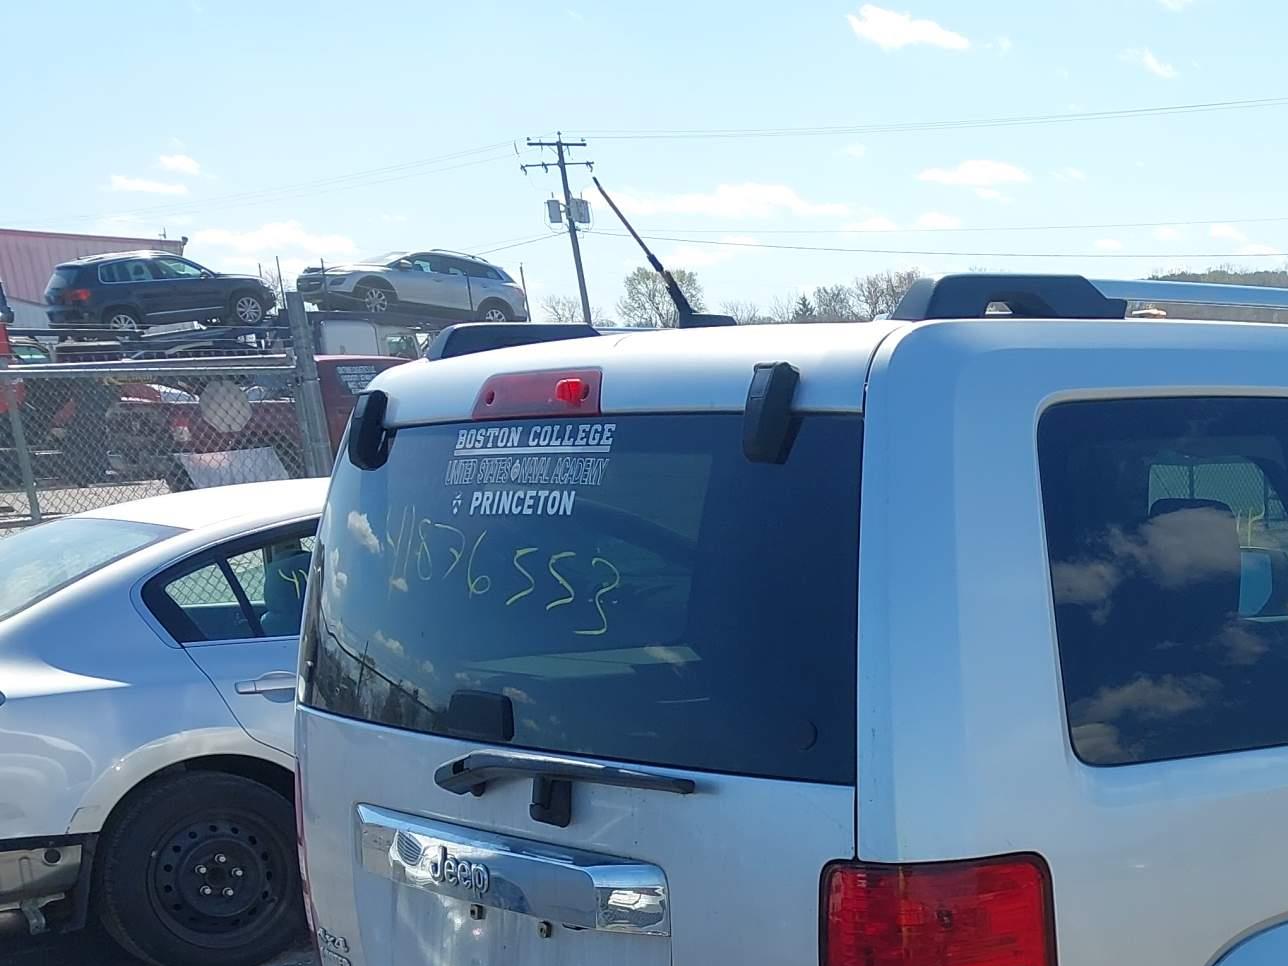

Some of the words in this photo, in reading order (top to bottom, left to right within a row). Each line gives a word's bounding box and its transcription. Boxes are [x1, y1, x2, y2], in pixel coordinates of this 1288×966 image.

[455, 427, 523, 449] BOSTON
[528, 424, 616, 446] COLLEGE
[444, 459, 478, 485] UNITED
[477, 457, 512, 484] STATES
[516, 457, 552, 484] NAVAL
[550, 457, 609, 485] ACADEMY
[469, 490, 576, 515] PRINCETON
[429, 845, 490, 899] Jeep
